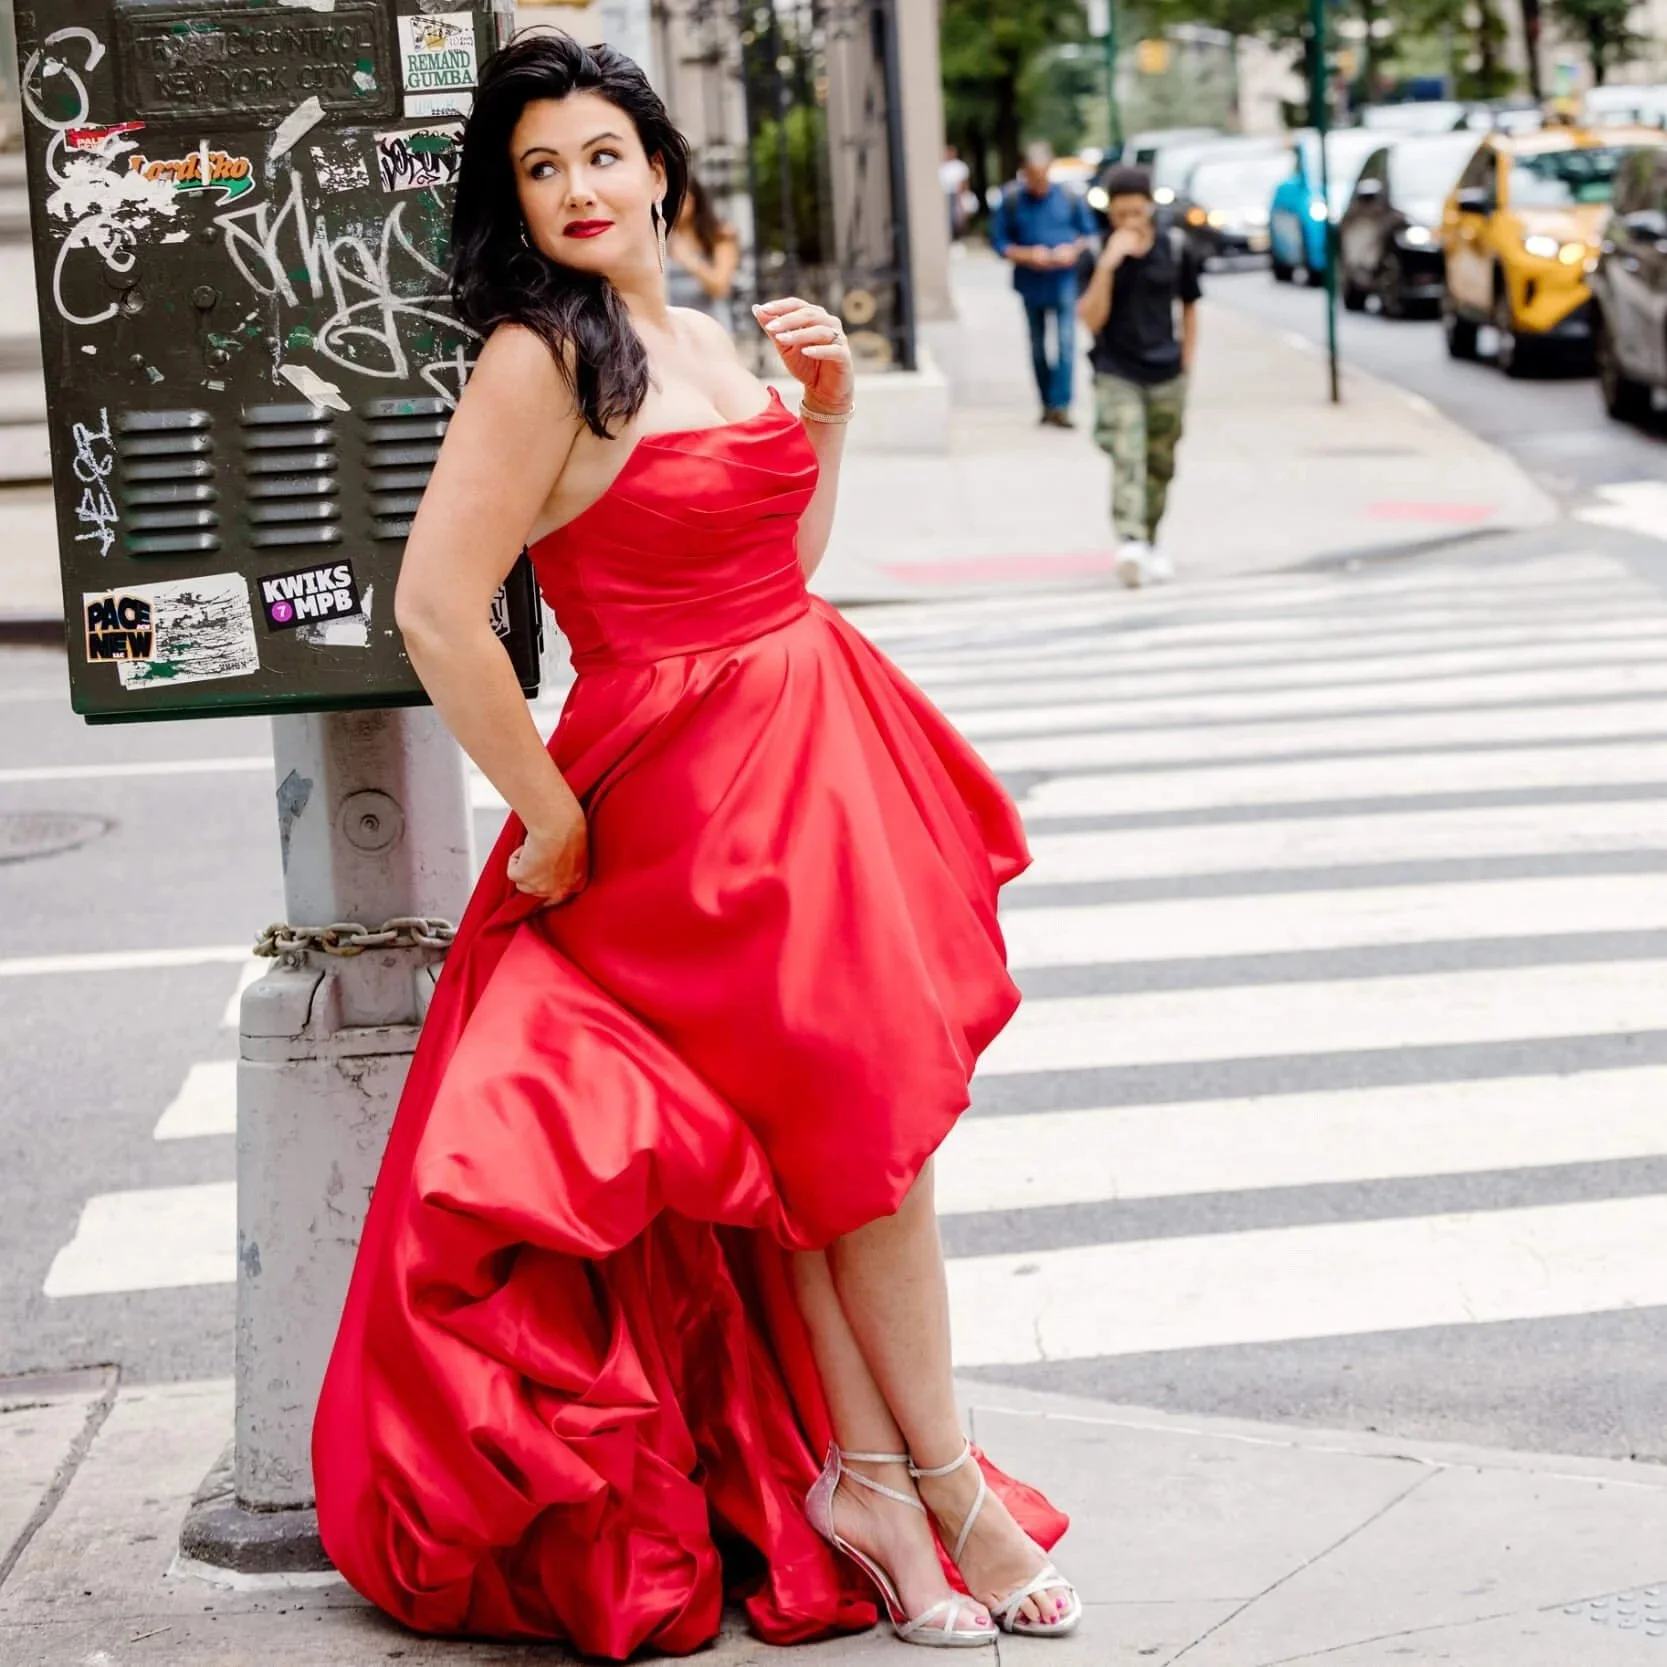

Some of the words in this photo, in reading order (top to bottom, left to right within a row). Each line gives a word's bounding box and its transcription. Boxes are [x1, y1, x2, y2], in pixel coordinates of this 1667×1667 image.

[408, 49, 471, 72] REMAND
[408, 69, 475, 88] GUMBA
[262, 565, 352, 603] KWIKS
[277, 605, 287, 618] 7
[294, 589, 353, 620] MPB
[89, 631, 153, 659] NEW
